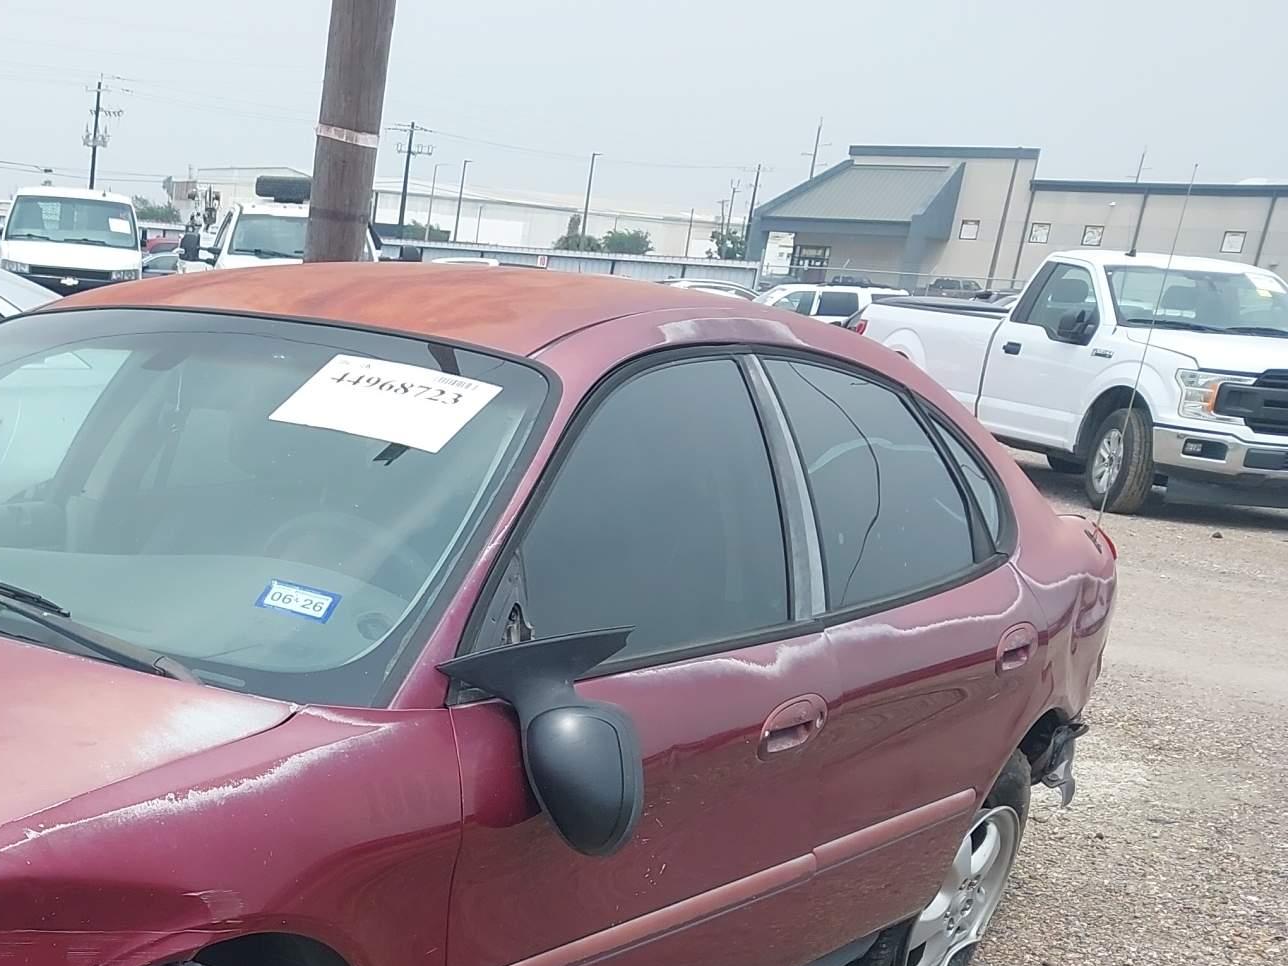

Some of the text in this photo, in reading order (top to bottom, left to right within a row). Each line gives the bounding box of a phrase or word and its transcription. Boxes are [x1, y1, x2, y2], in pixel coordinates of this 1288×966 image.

[330, 371, 464, 405] 44968723
[270, 591, 325, 613] 06 26
